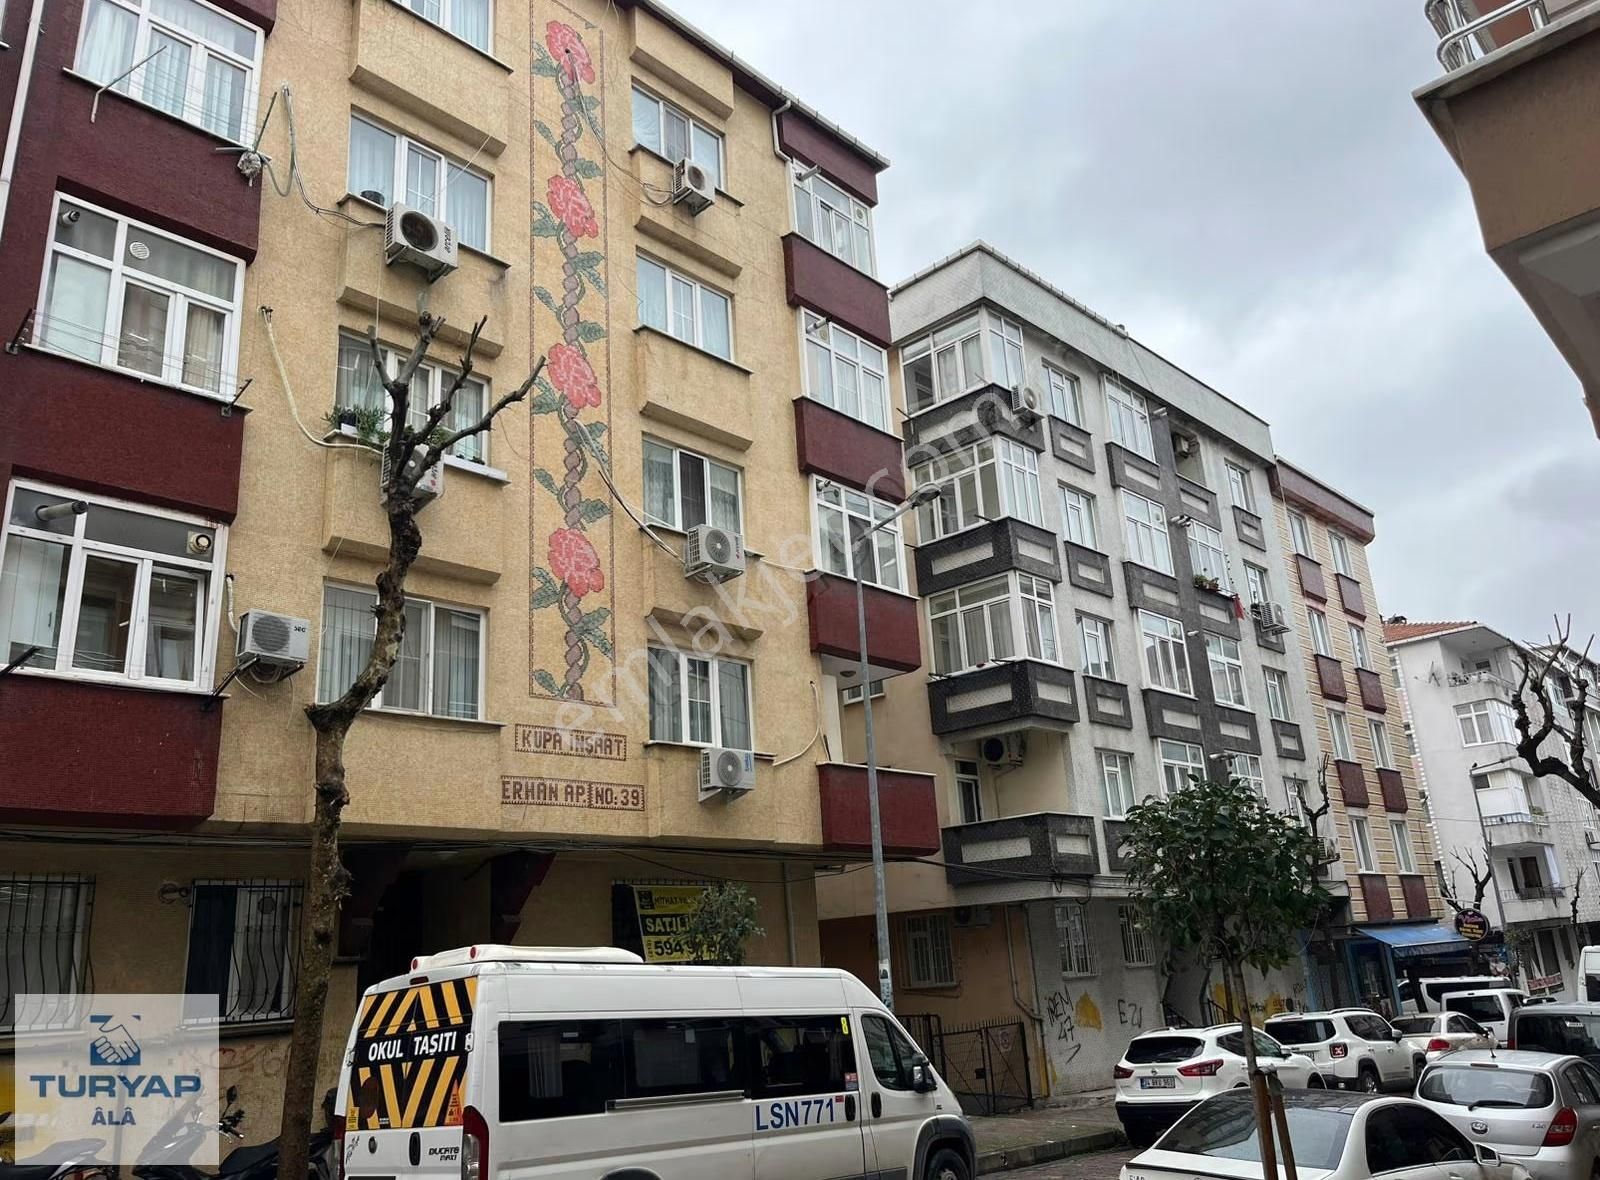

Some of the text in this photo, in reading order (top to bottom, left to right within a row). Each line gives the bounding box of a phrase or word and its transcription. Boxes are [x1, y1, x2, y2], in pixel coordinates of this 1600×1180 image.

[521, 729, 624, 756] KUPA İNŞAAT
[501, 780, 559, 802] ERHAN
[840, 1016, 849, 1035] 8
[368, 1031, 457, 1062] OKUL TAŞITI
[755, 1098, 835, 1131] LSN771
[428, 1146, 460, 1156] DUCATO
